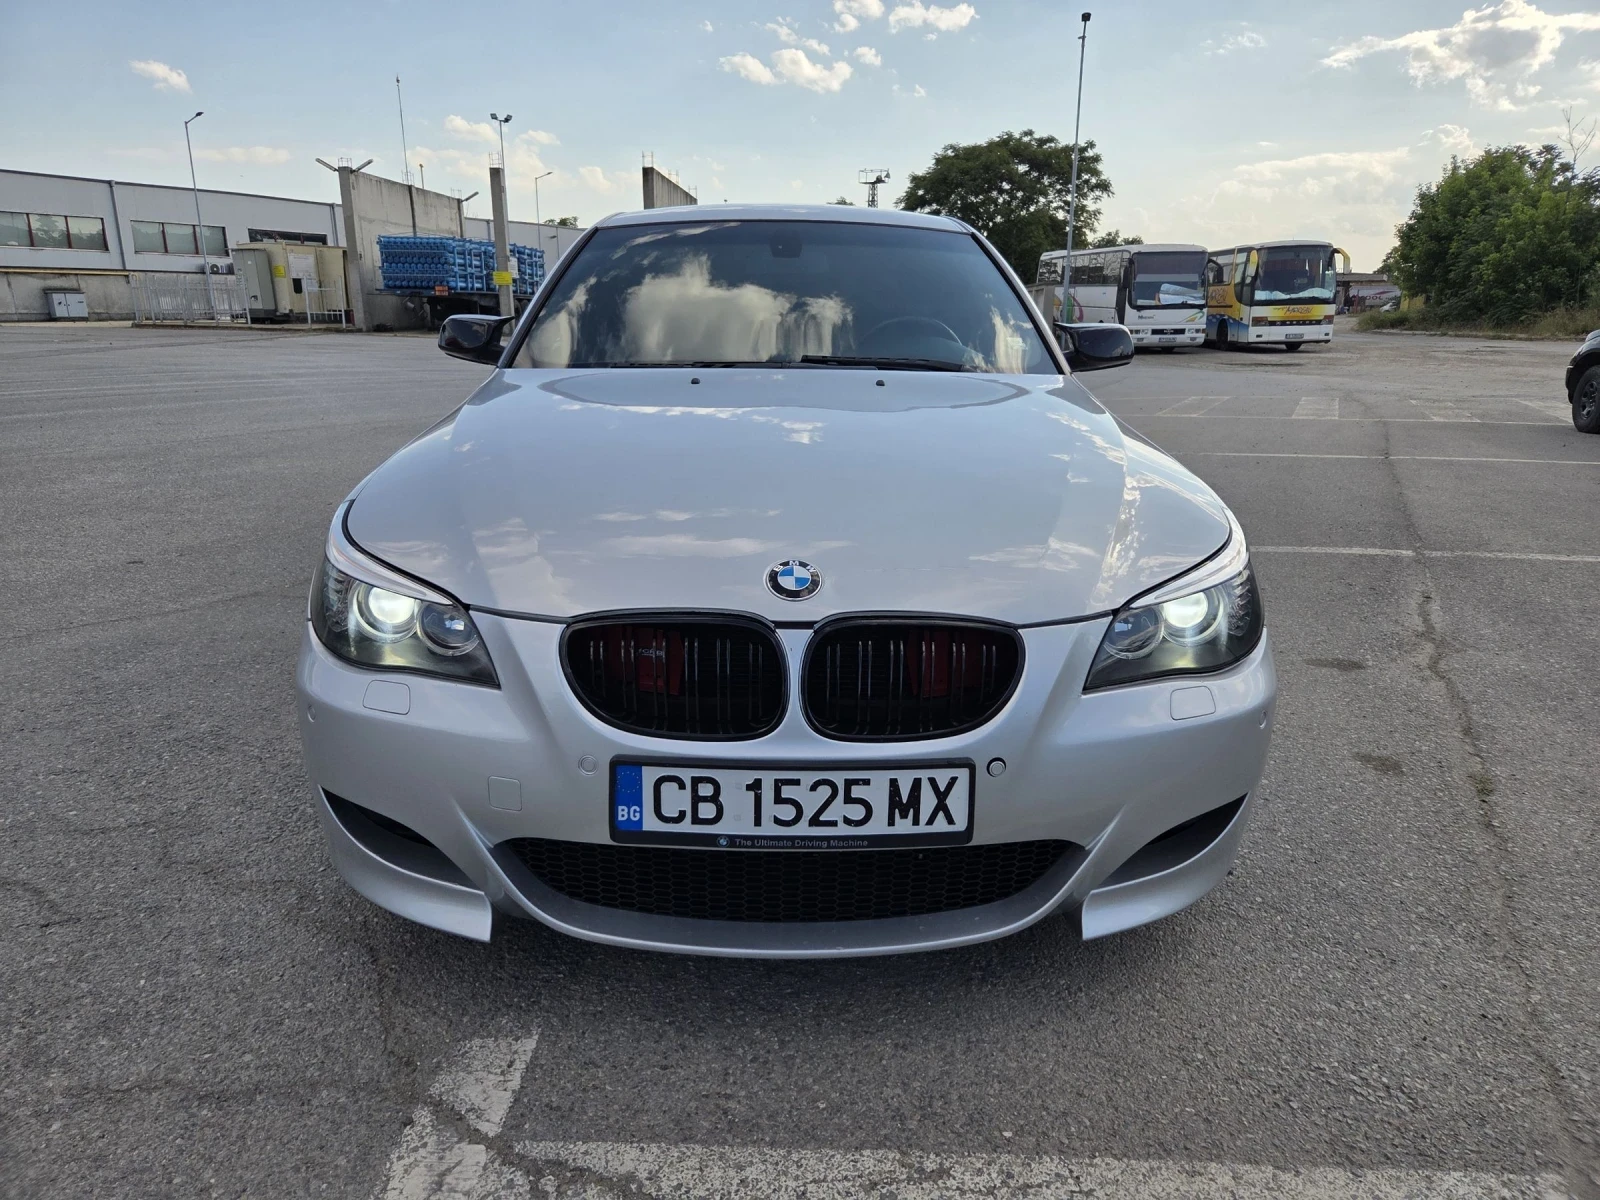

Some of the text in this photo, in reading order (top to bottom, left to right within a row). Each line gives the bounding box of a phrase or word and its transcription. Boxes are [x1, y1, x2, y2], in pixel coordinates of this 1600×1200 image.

[774, 560, 817, 572] BMW
[653, 774, 959, 827] CB 1525 MX
[617, 805, 640, 821] BG
[735, 838, 868, 848] The Ultimate Driving Machine
